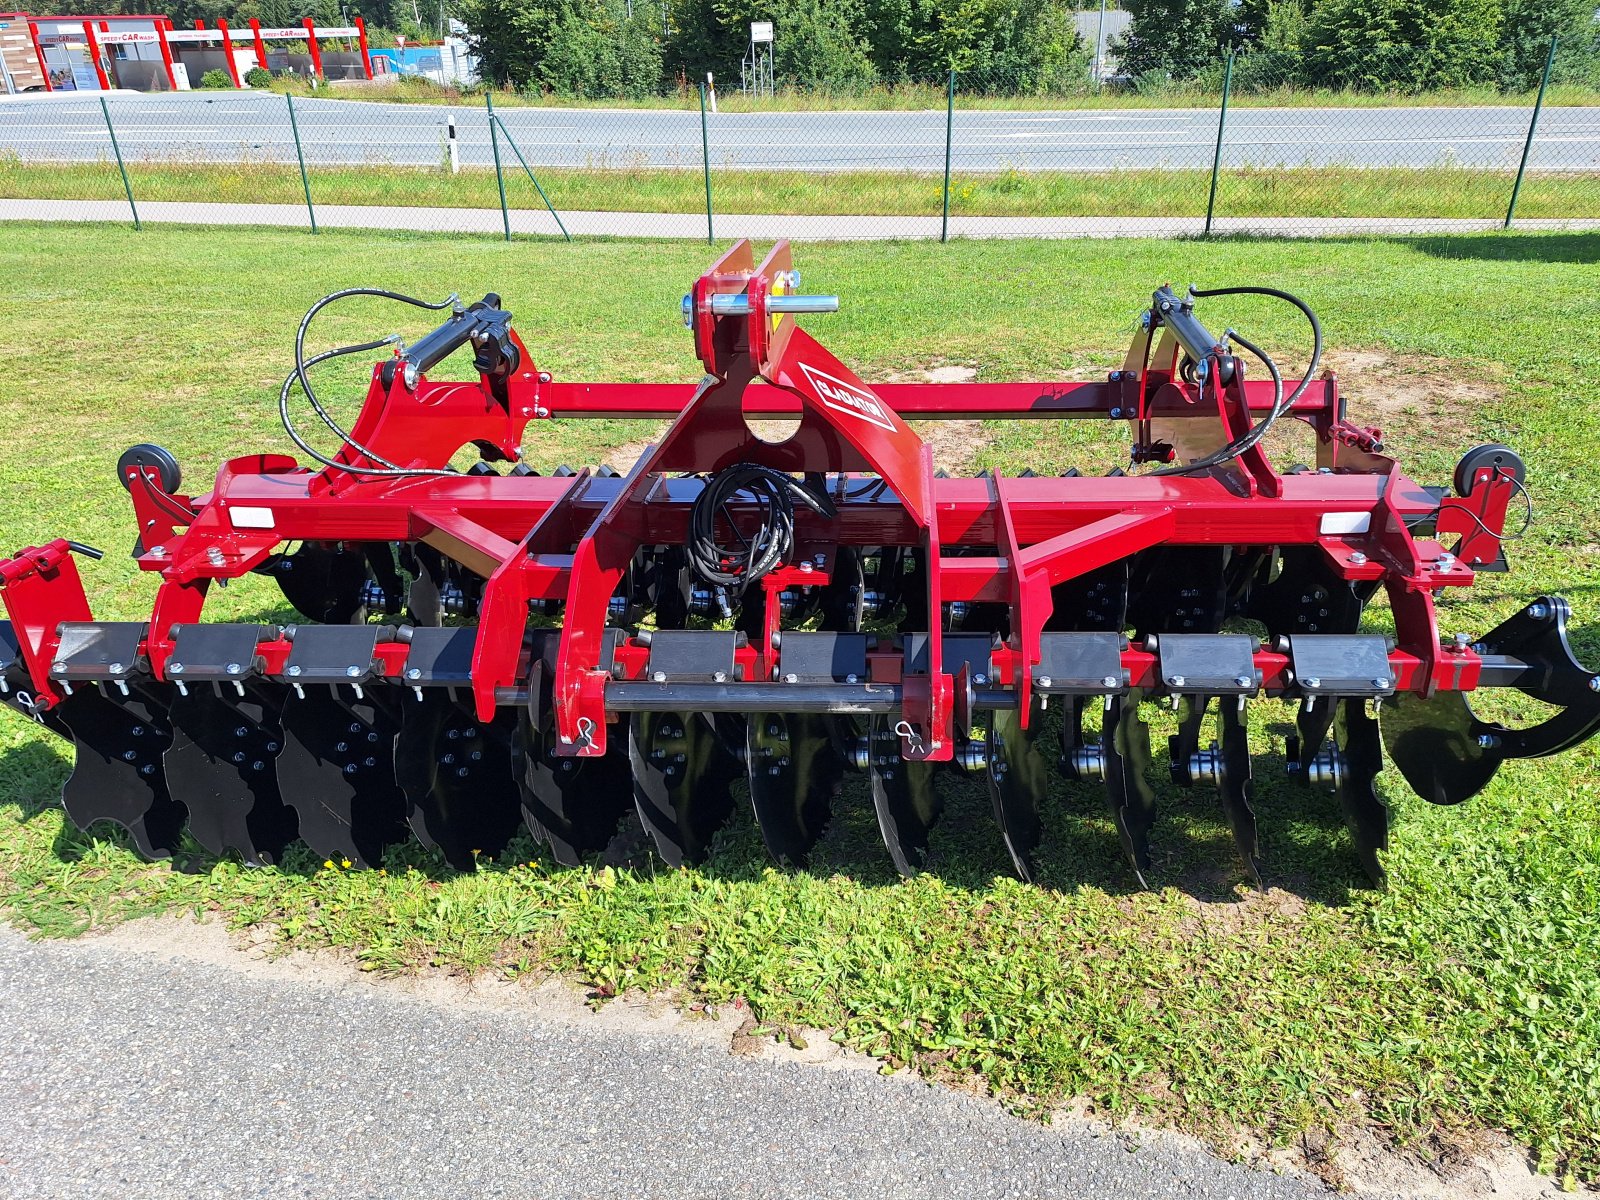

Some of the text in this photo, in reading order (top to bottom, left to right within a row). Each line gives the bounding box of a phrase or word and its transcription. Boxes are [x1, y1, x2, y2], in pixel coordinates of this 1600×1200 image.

[58, 35, 70, 43] CAR
[122, 33, 139, 41] CAR
[816, 379, 885, 419] GLADIATOR
